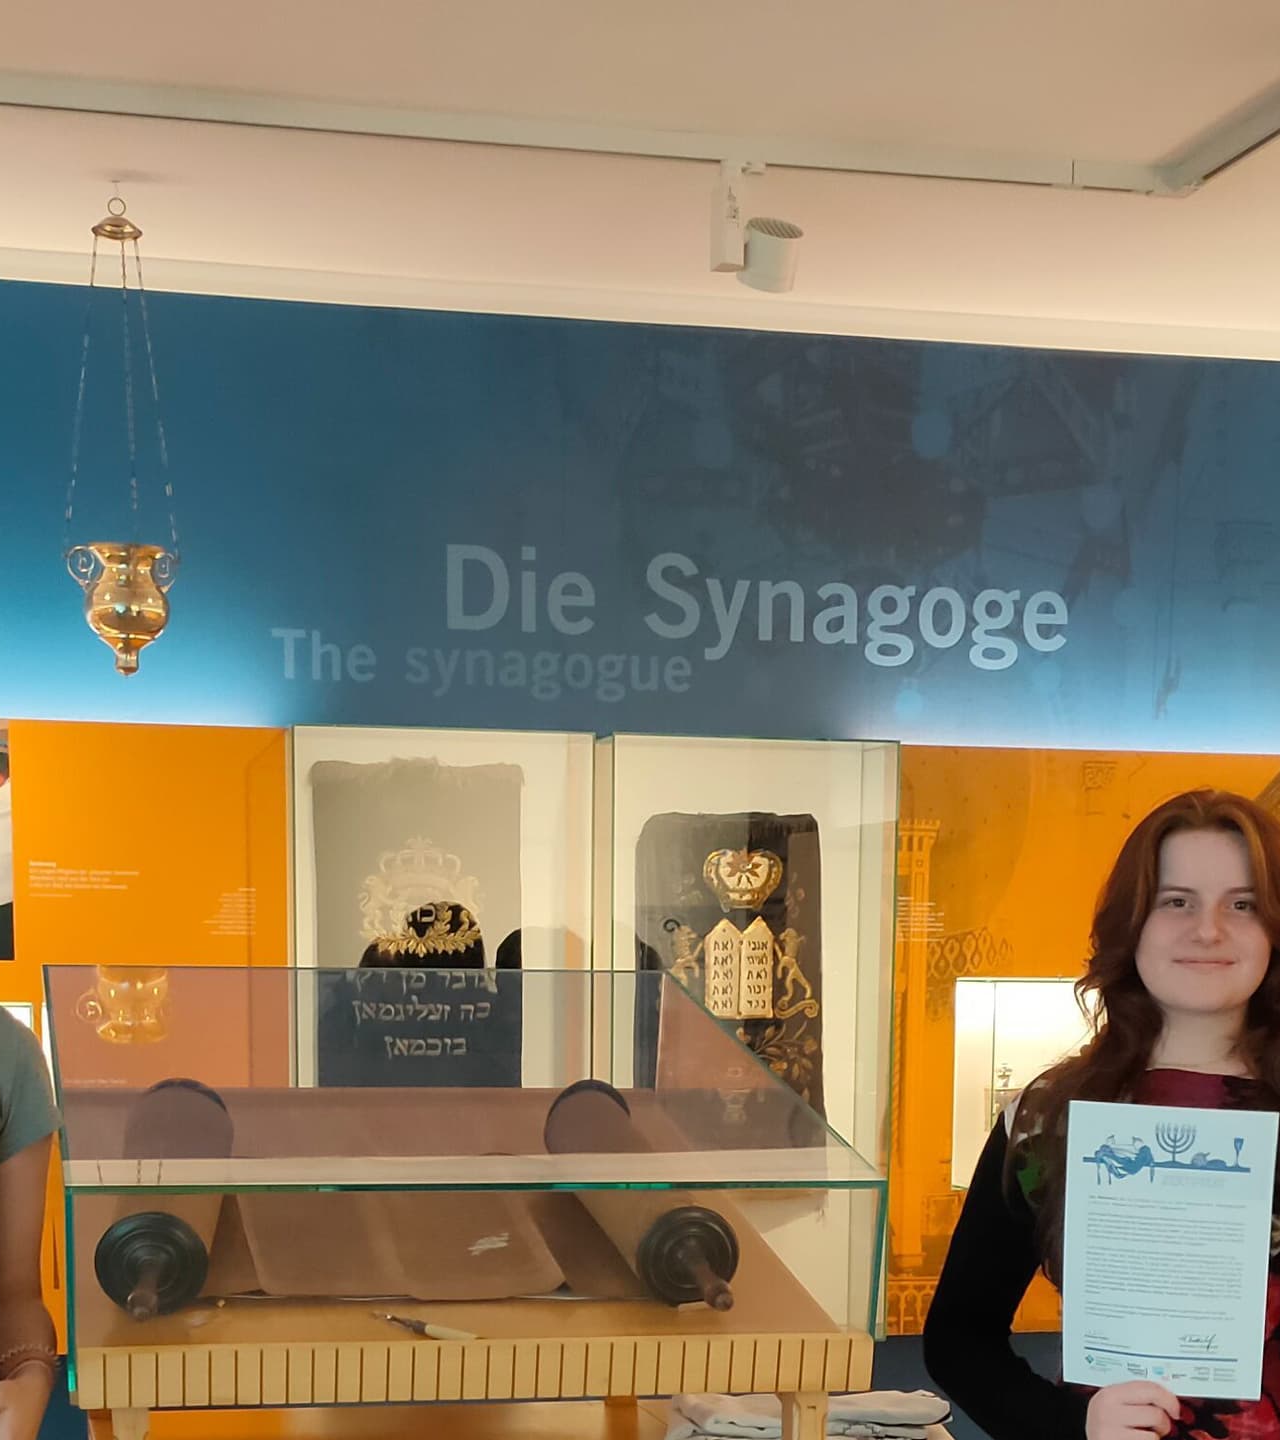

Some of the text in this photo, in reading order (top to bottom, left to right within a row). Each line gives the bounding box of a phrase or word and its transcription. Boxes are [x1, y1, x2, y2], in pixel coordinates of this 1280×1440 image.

[445, 543, 1070, 671] Die Synagoge
[272, 626, 693, 703] The synagogue
